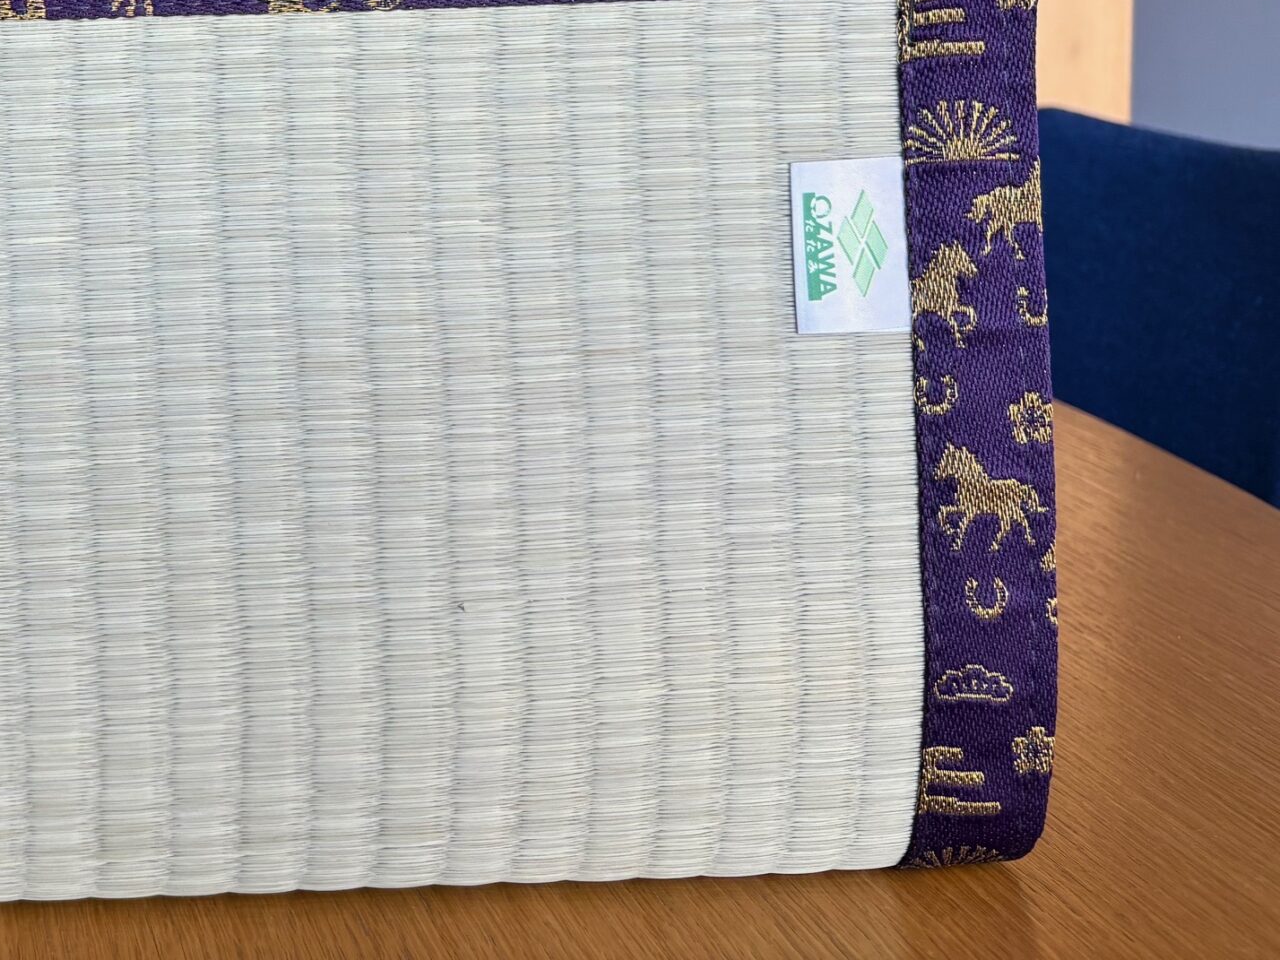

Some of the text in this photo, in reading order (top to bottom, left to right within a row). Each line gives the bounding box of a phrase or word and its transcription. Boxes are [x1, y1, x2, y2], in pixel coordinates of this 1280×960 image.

[805, 220, 819, 273] たたみ
[810, 195, 837, 296] OZAWA
